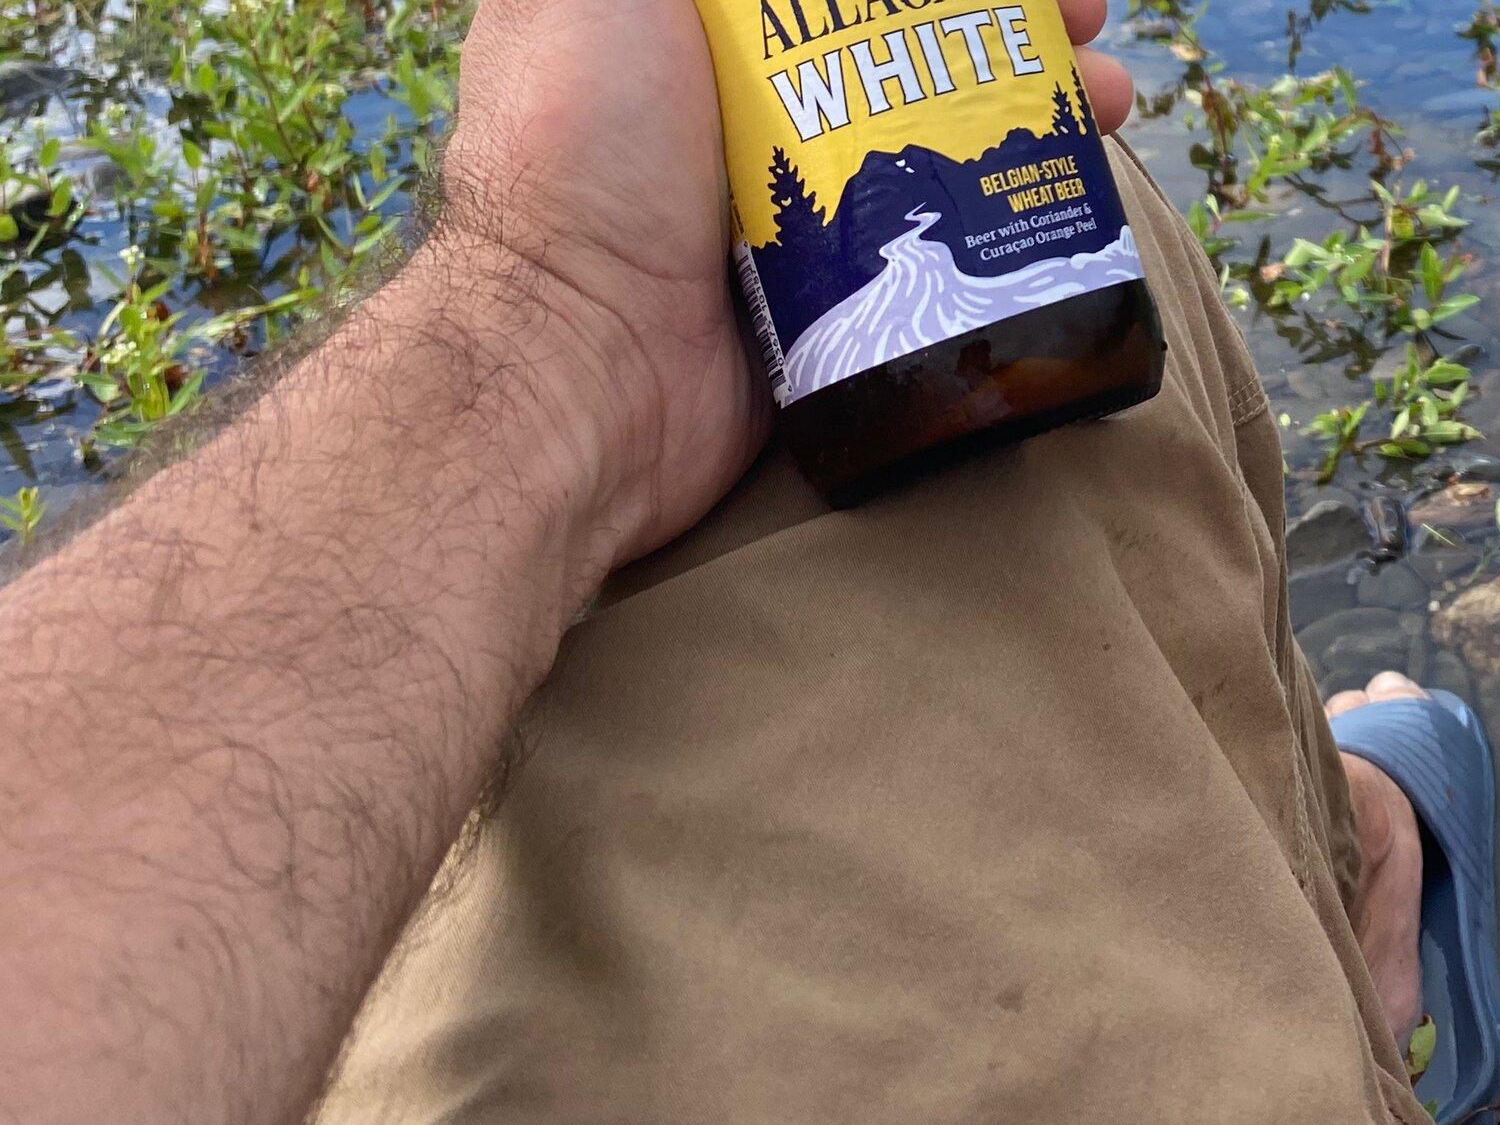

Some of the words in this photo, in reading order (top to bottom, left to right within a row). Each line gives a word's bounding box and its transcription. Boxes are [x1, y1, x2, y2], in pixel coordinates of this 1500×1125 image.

[766, 5, 1045, 143] WHITE
[980, 155, 1078, 196] BELGIAN-STYLE
[1007, 184, 1055, 213] WHEAT
[1054, 177, 1087, 201] BEER
[964, 229, 998, 249] Beer
[998, 219, 1030, 238] with
[1030, 205, 1084, 229] Coriander
[1083, 202, 1093, 215] &
[980, 236, 1035, 261] Curaçao
[1035, 225, 1076, 245] Orange
[1075, 217, 1098, 234] Peel
